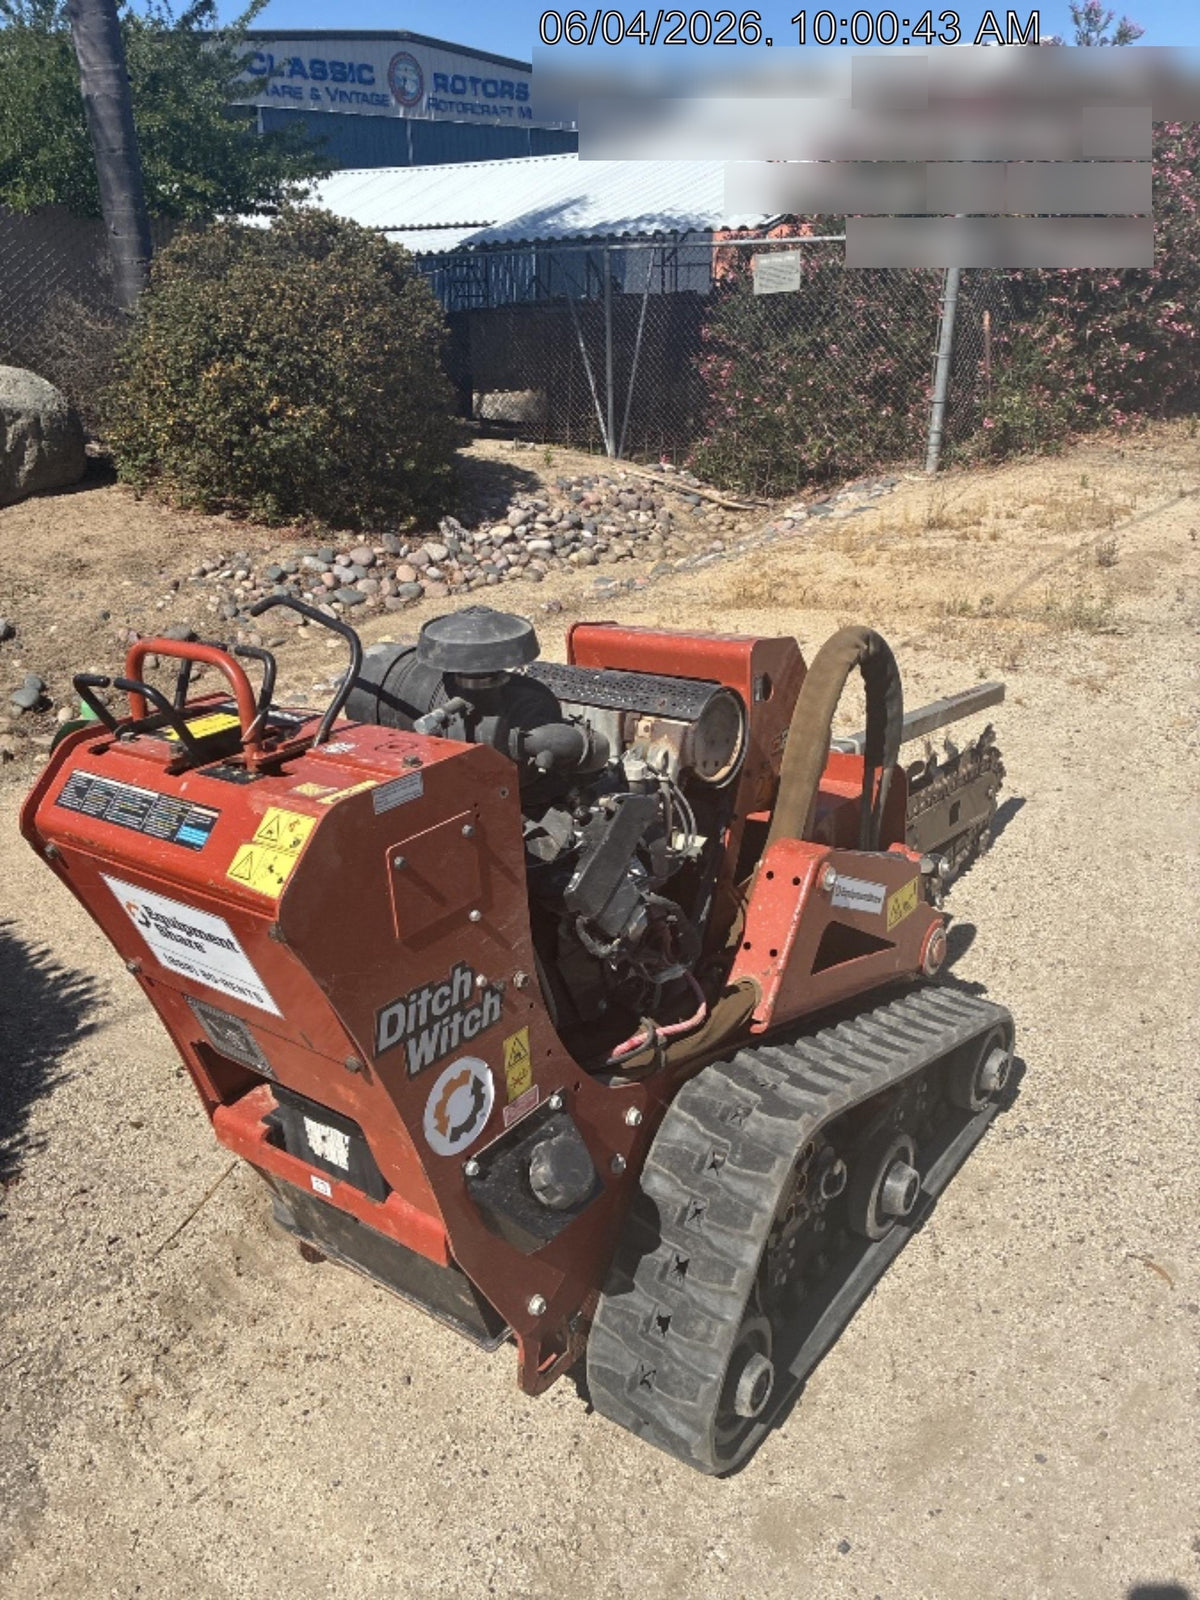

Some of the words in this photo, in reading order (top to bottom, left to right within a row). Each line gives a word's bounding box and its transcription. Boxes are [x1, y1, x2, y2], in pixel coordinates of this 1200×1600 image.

[247, 51, 375, 86] CLASSIC
[433, 72, 530, 101] ROTORS
[264, 84, 304, 100] ARE
[310, 87, 322, 101] &
[325, 86, 391, 107] VINTAGE
[428, 97, 514, 119] ROTORCRAFT
[141, 904, 240, 954] Equipment
[154, 923, 207, 954] Share
[377, 965, 473, 1053] Ditch
[406, 990, 502, 1076] Witch
